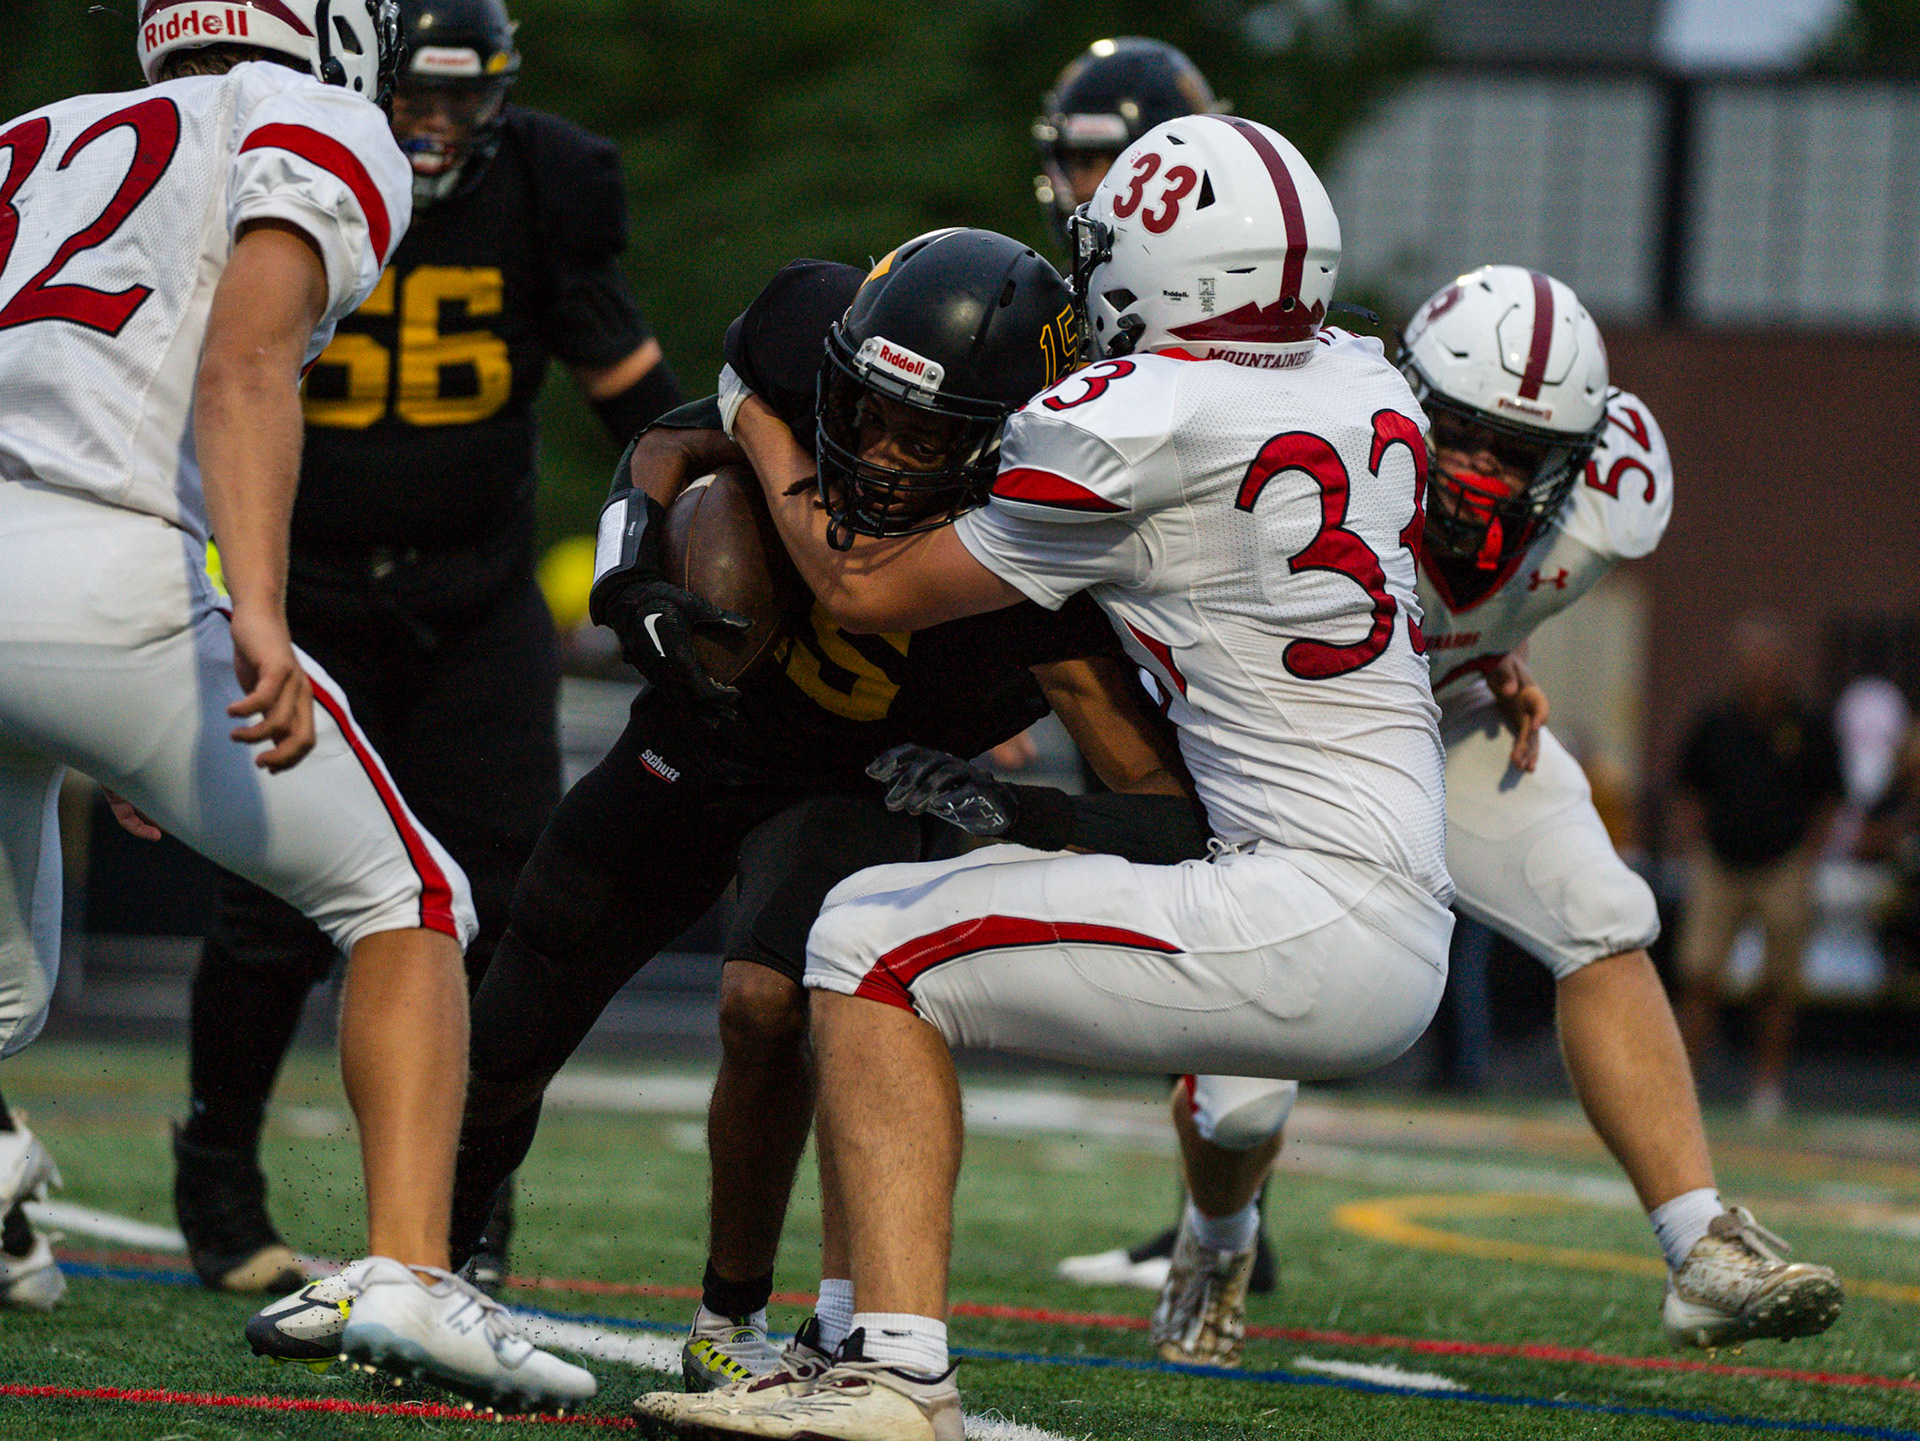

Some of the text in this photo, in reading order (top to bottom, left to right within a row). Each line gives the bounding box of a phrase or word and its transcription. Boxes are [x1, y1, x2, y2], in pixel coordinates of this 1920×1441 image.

[144, 9, 249, 53] Riddell
[1113, 152, 1198, 234] 33
[880, 344, 925, 376] Riddell
[1234, 408, 1429, 681] 33
